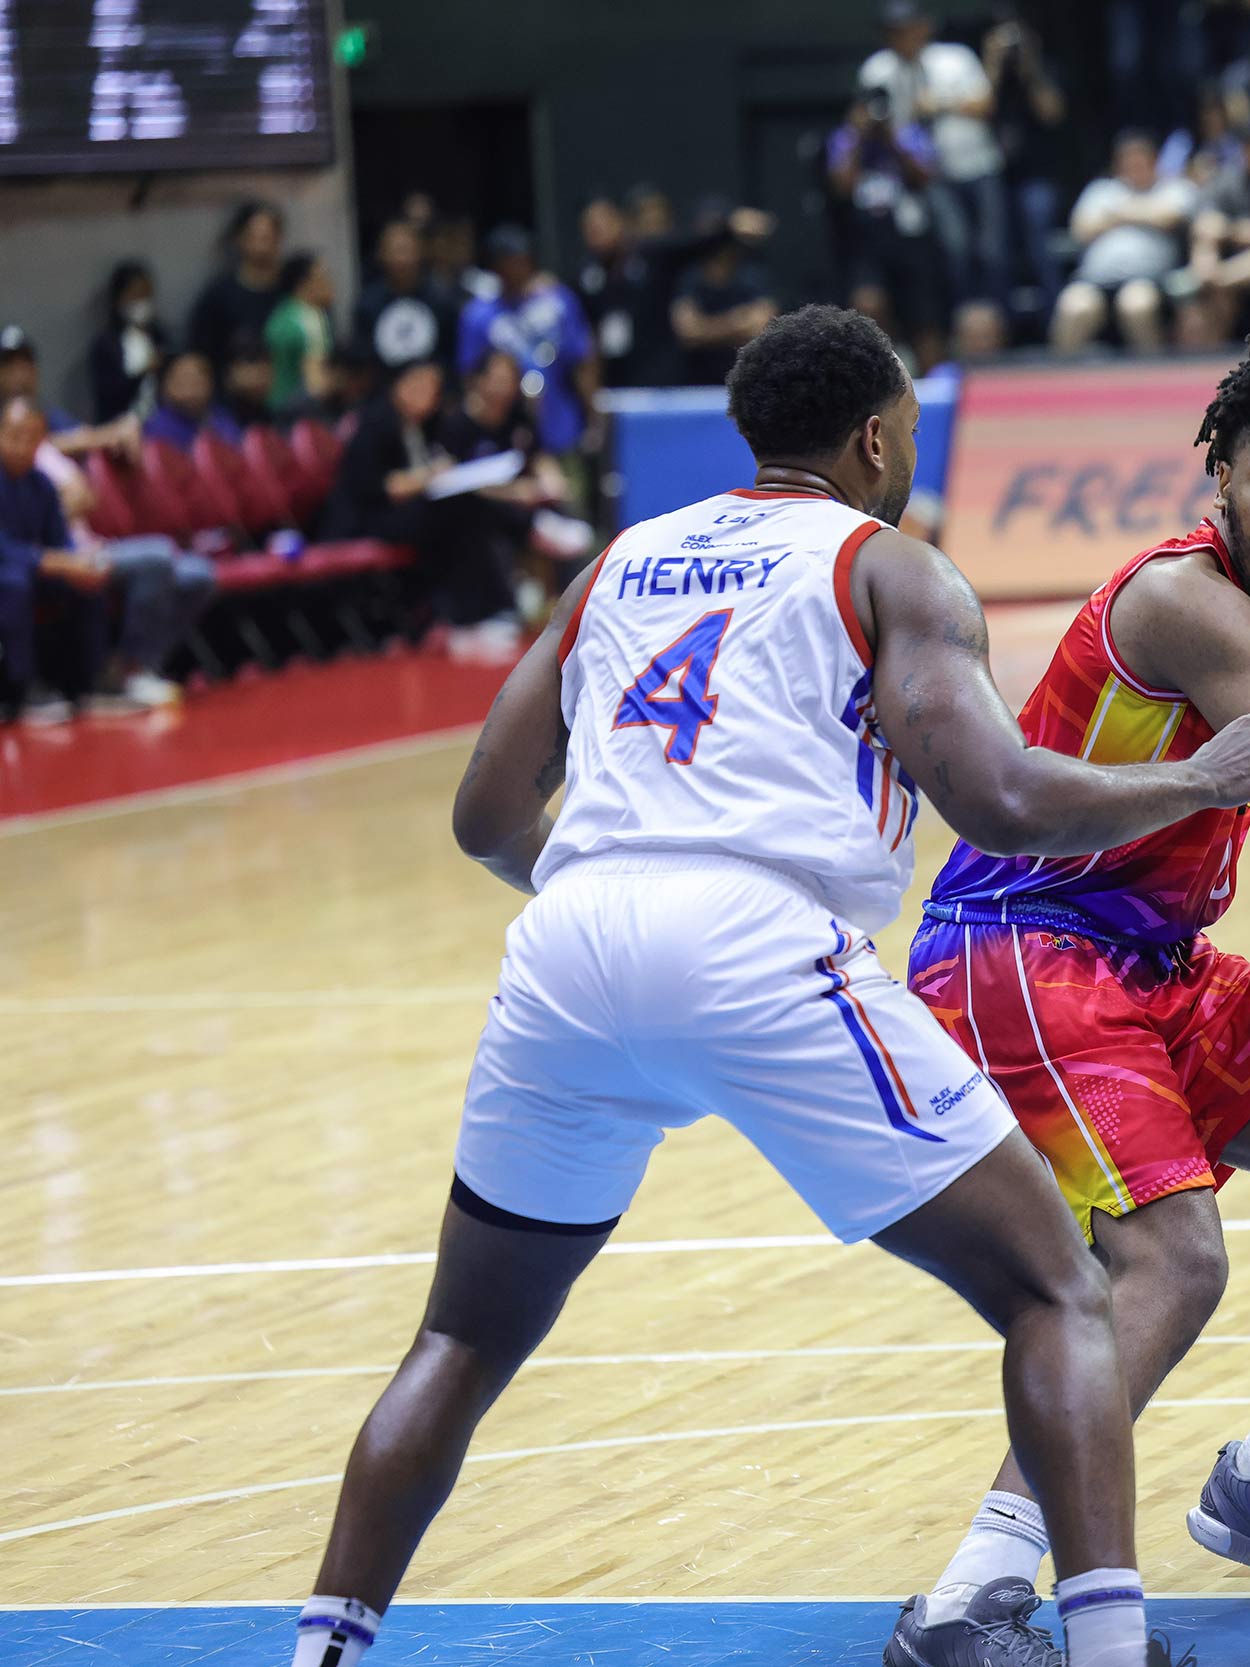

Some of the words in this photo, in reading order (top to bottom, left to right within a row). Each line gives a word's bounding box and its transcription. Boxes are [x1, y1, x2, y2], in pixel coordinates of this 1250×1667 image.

[684, 534, 713, 544] NLEX
[618, 552, 792, 599] HENRY
[611, 608, 735, 765] 4
[935, 1071, 983, 1116] CONNECTO
